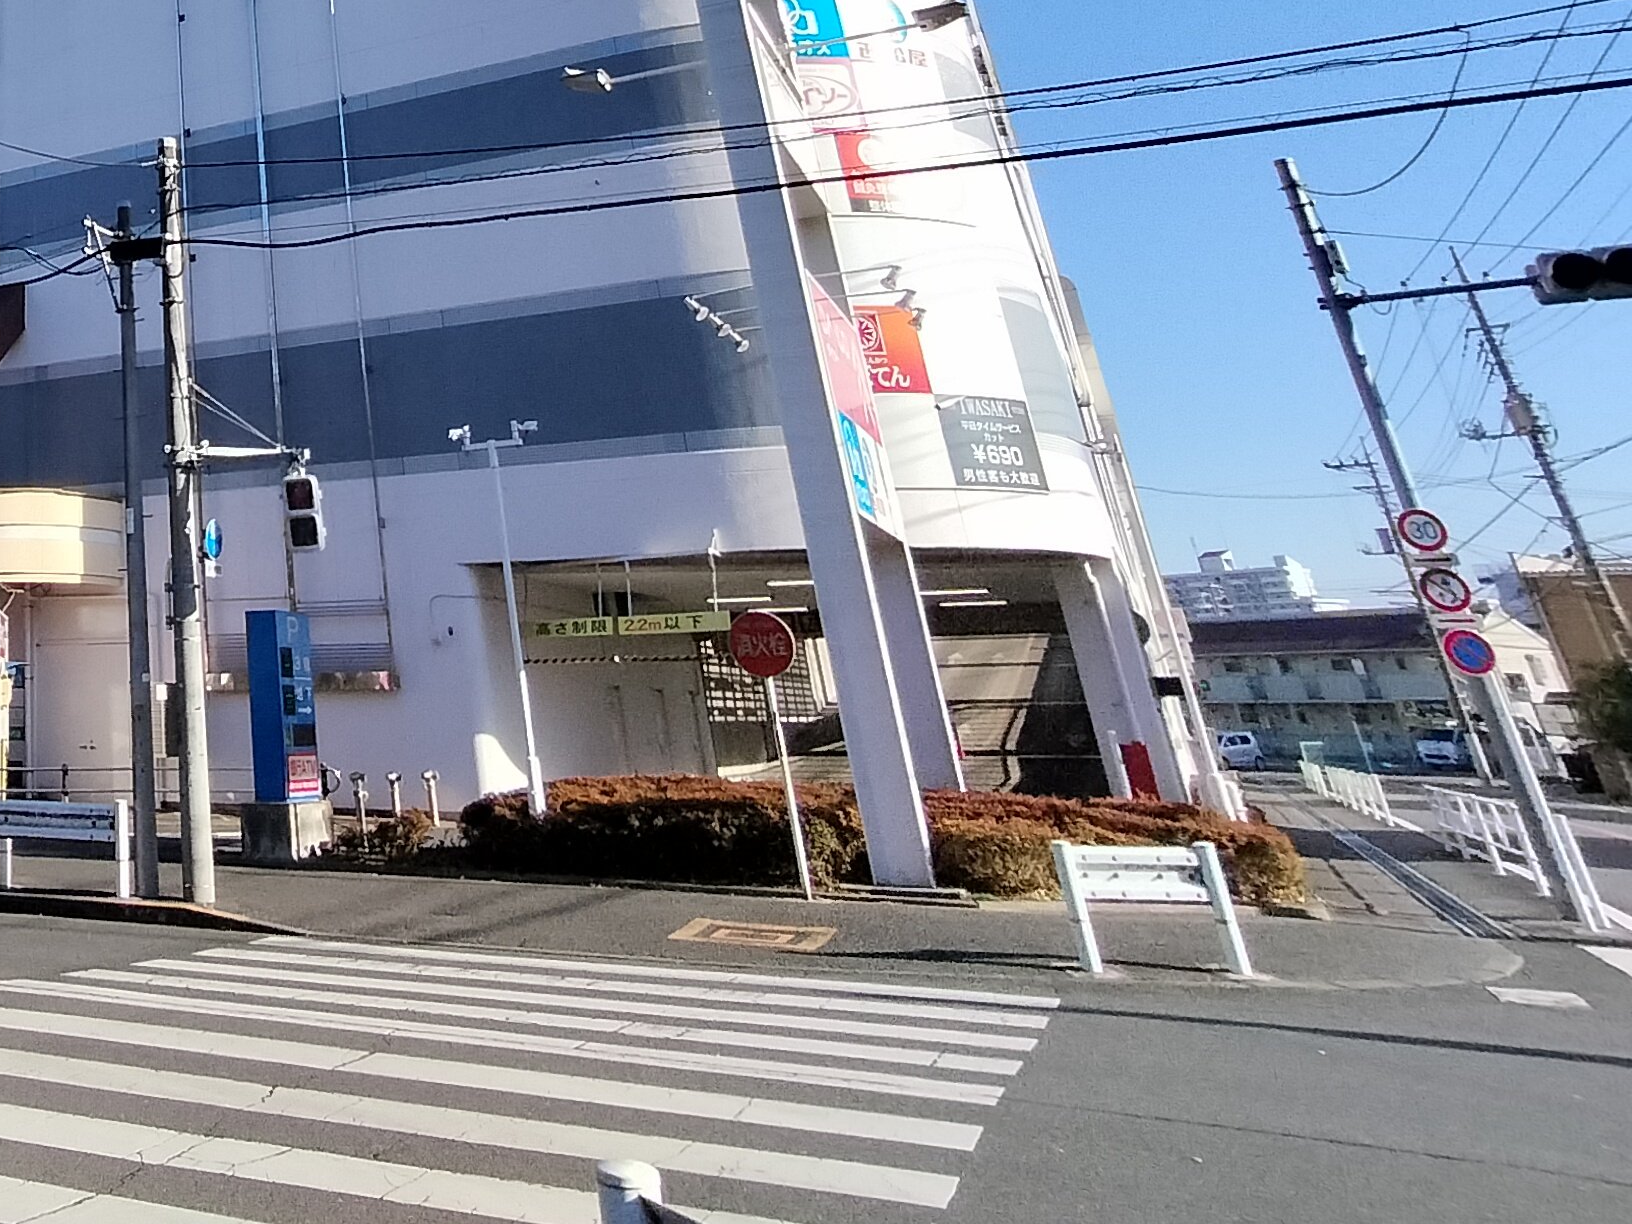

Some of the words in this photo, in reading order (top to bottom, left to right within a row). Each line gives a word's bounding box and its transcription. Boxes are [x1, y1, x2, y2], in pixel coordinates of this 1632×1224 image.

[959, 399, 1013, 418] IWASAKI
[1409, 521, 1438, 540] 30
[287, 616, 299, 643] P
[535, 619, 607, 637] 高さ制限
[736, 630, 788, 657] 消火栓
